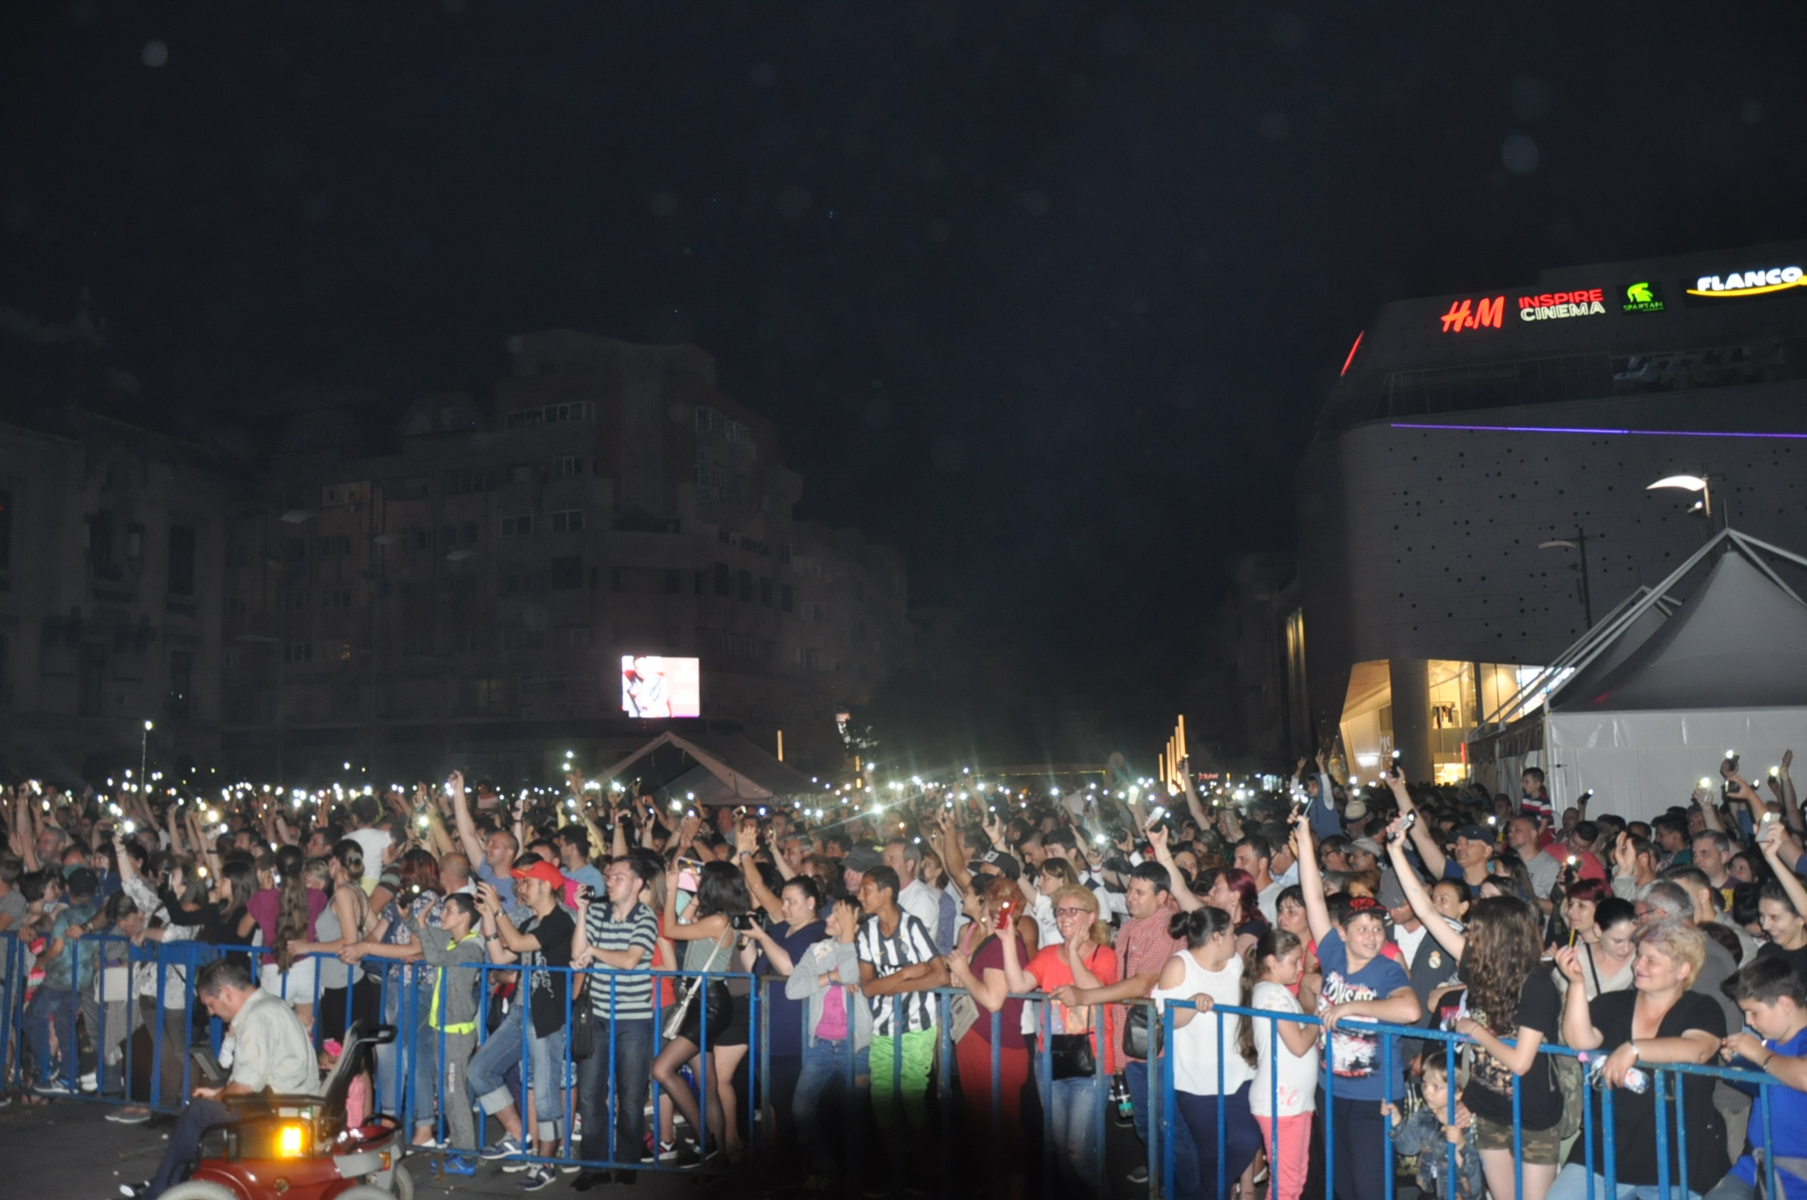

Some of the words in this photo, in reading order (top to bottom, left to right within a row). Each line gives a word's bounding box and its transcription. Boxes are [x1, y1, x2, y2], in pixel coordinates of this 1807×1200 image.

[1697, 266, 1803, 292] FLANCO
[1518, 288, 1604, 310] INSPIRE
[1622, 301, 1663, 311] SPARTAN
[1441, 295, 1505, 333] H&M
[1519, 300, 1606, 322] CINEMA
